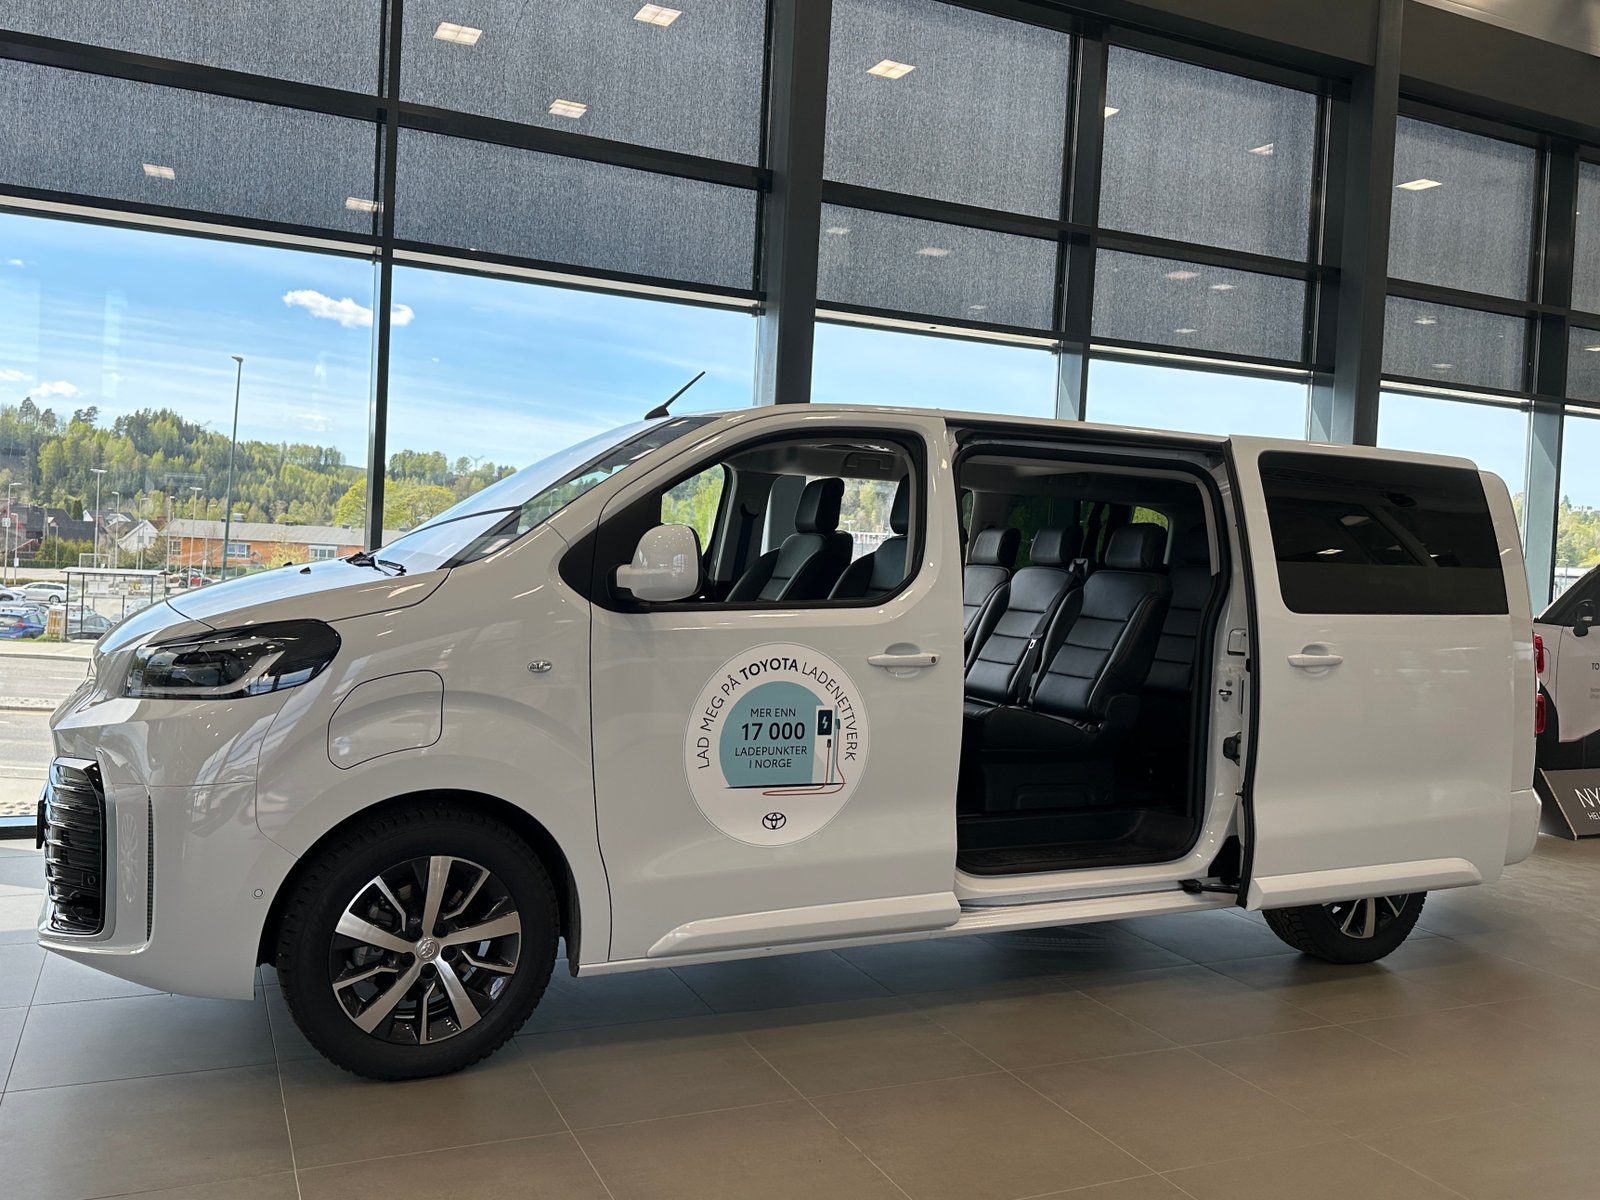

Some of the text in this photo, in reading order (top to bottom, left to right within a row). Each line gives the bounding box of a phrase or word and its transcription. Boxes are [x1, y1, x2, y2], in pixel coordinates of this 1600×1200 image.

[696, 657, 858, 769] LAD MEG PÅ TOYOTA LADENETTVERK
[750, 708, 796, 718] MER ENN
[741, 722, 805, 741] 17 000
[735, 745, 807, 756] LADEPUNKTER
[749, 758, 792, 768] I NORGE
[1575, 787, 1600, 808] NY
